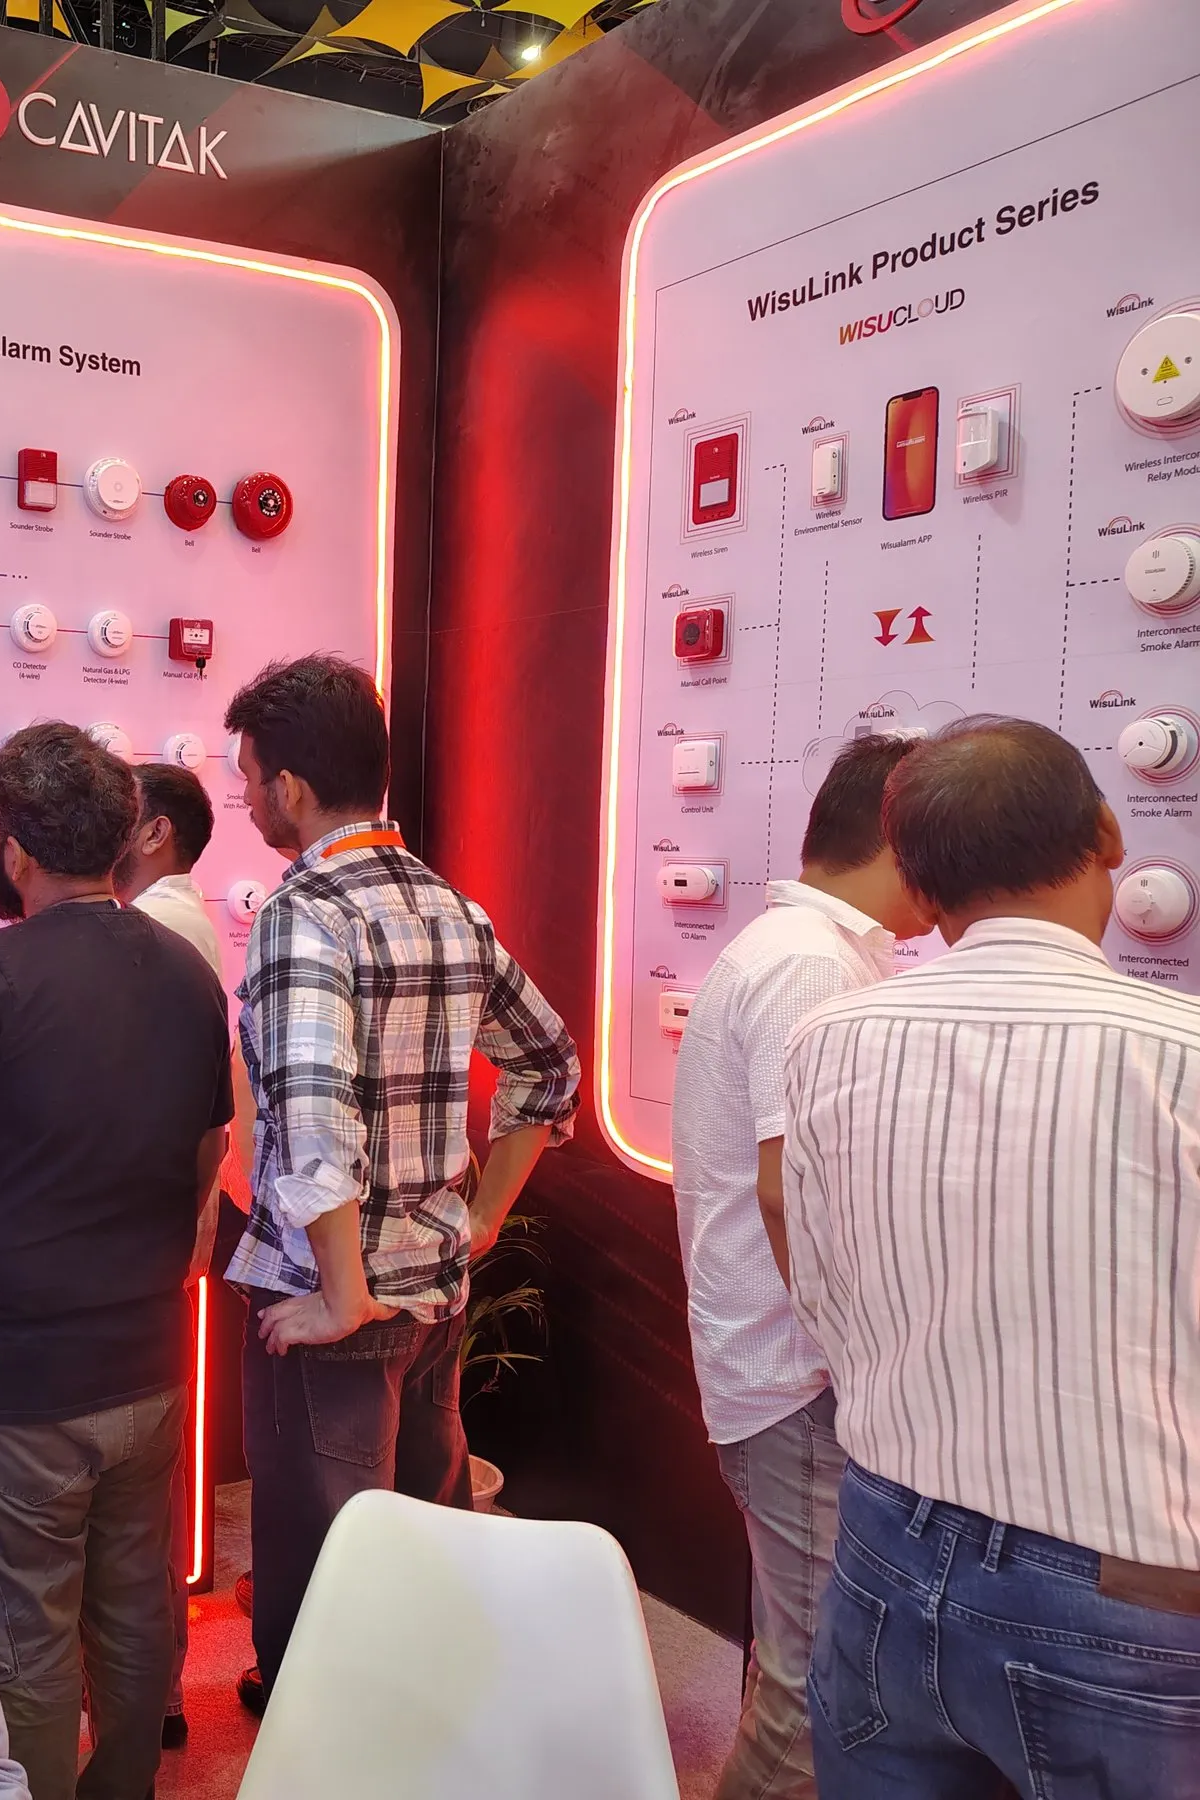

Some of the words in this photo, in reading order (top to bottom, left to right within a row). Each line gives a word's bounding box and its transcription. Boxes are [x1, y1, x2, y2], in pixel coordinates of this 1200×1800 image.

[17, 92, 228, 180] CAVITAK
[747, 262, 863, 322] WisuLink
[871, 217, 985, 280] Product
[995, 181, 1100, 236] Series
[1106, 297, 1154, 317] WisuLink
[839, 288, 965, 345] WISUCLOUD
[58, 345, 141, 376] System
[801, 419, 835, 435] WisuLink
[1124, 458, 1162, 473] Wireless
[1147, 470, 1173, 483] Relay
[963, 492, 994, 505] Wireless
[994, 489, 1008, 499] PIR
[815, 509, 841, 520] Wireless
[9, 522, 34, 531] Sounder
[35, 525, 54, 533] Strobe
[794, 520, 840, 536] Environmental
[840, 517, 863, 527] Sensor
[1097, 521, 1146, 537] WisuLink
[89, 530, 113, 539] Sounder
[113, 533, 132, 541] Strobe
[184, 539, 195, 547] Bell
[880, 538, 917, 551] Wisualarm
[917, 534, 933, 543] APP
[690, 549, 713, 559] Wireless
[714, 545, 729, 555] Siren
[1137, 624, 1200, 638] Interconnecte
[1140, 641, 1172, 652] Smoke
[12, 661, 22, 669] CO
[22, 663, 47, 671] Detector
[82, 666, 103, 675] Natural
[103, 667, 114, 675] Gas
[119, 668, 131, 676] LPG
[83, 676, 107, 685] Detector
[680, 679, 701, 688] Manual
[1089, 697, 1136, 709] WisuLink
[1126, 793, 1198, 803] Interconnected
[680, 806, 701, 814] Control
[1130, 808, 1162, 818] Smoke
[1164, 808, 1193, 817] Alarm
[674, 920, 715, 931] Interconnected
[690, 933, 707, 941] Alarm
[895, 948, 919, 957] uLink
[1118, 953, 1190, 967] Interconnected
[1127, 968, 1149, 979] Heat
[1150, 970, 1179, 981] Alarm
